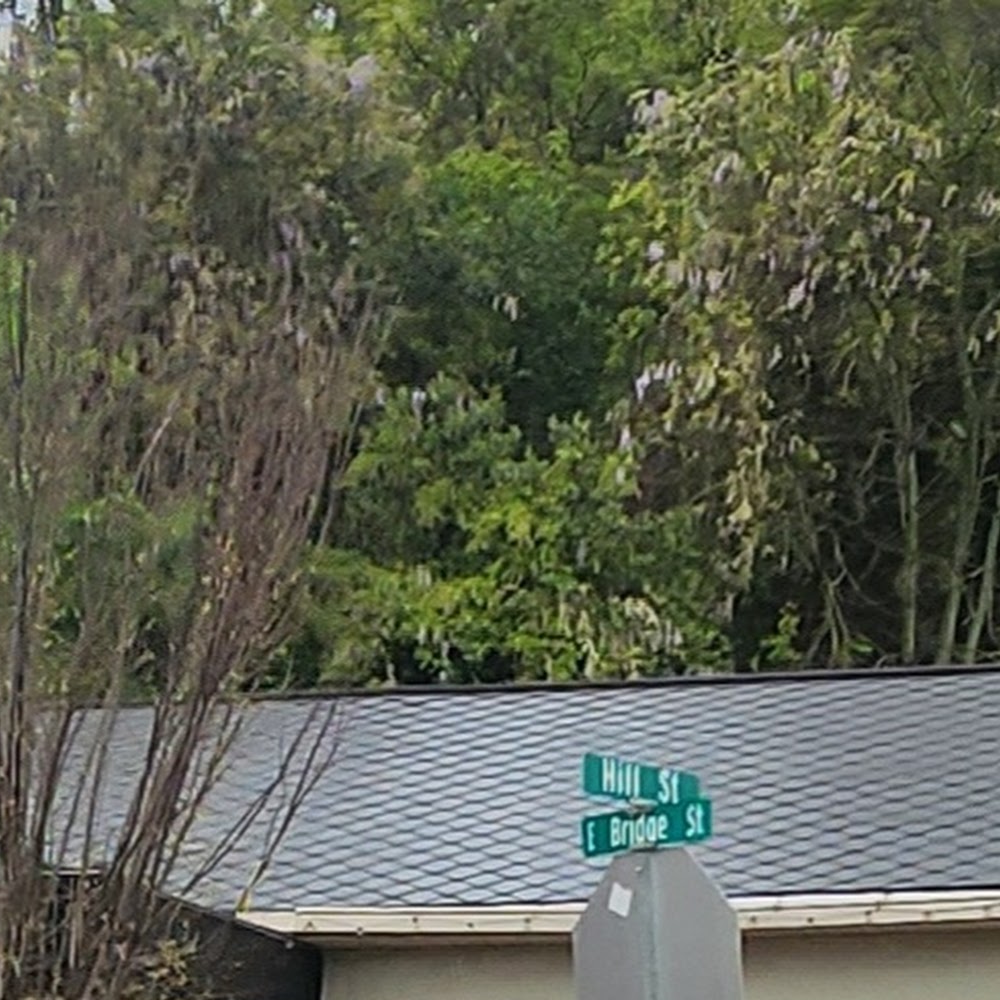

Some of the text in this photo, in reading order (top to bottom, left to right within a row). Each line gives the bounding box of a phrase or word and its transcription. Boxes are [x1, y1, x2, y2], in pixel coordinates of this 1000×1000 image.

[602, 757, 680, 804] Hill St
[610, 814, 669, 848] Bridge
[685, 803, 705, 837] St
